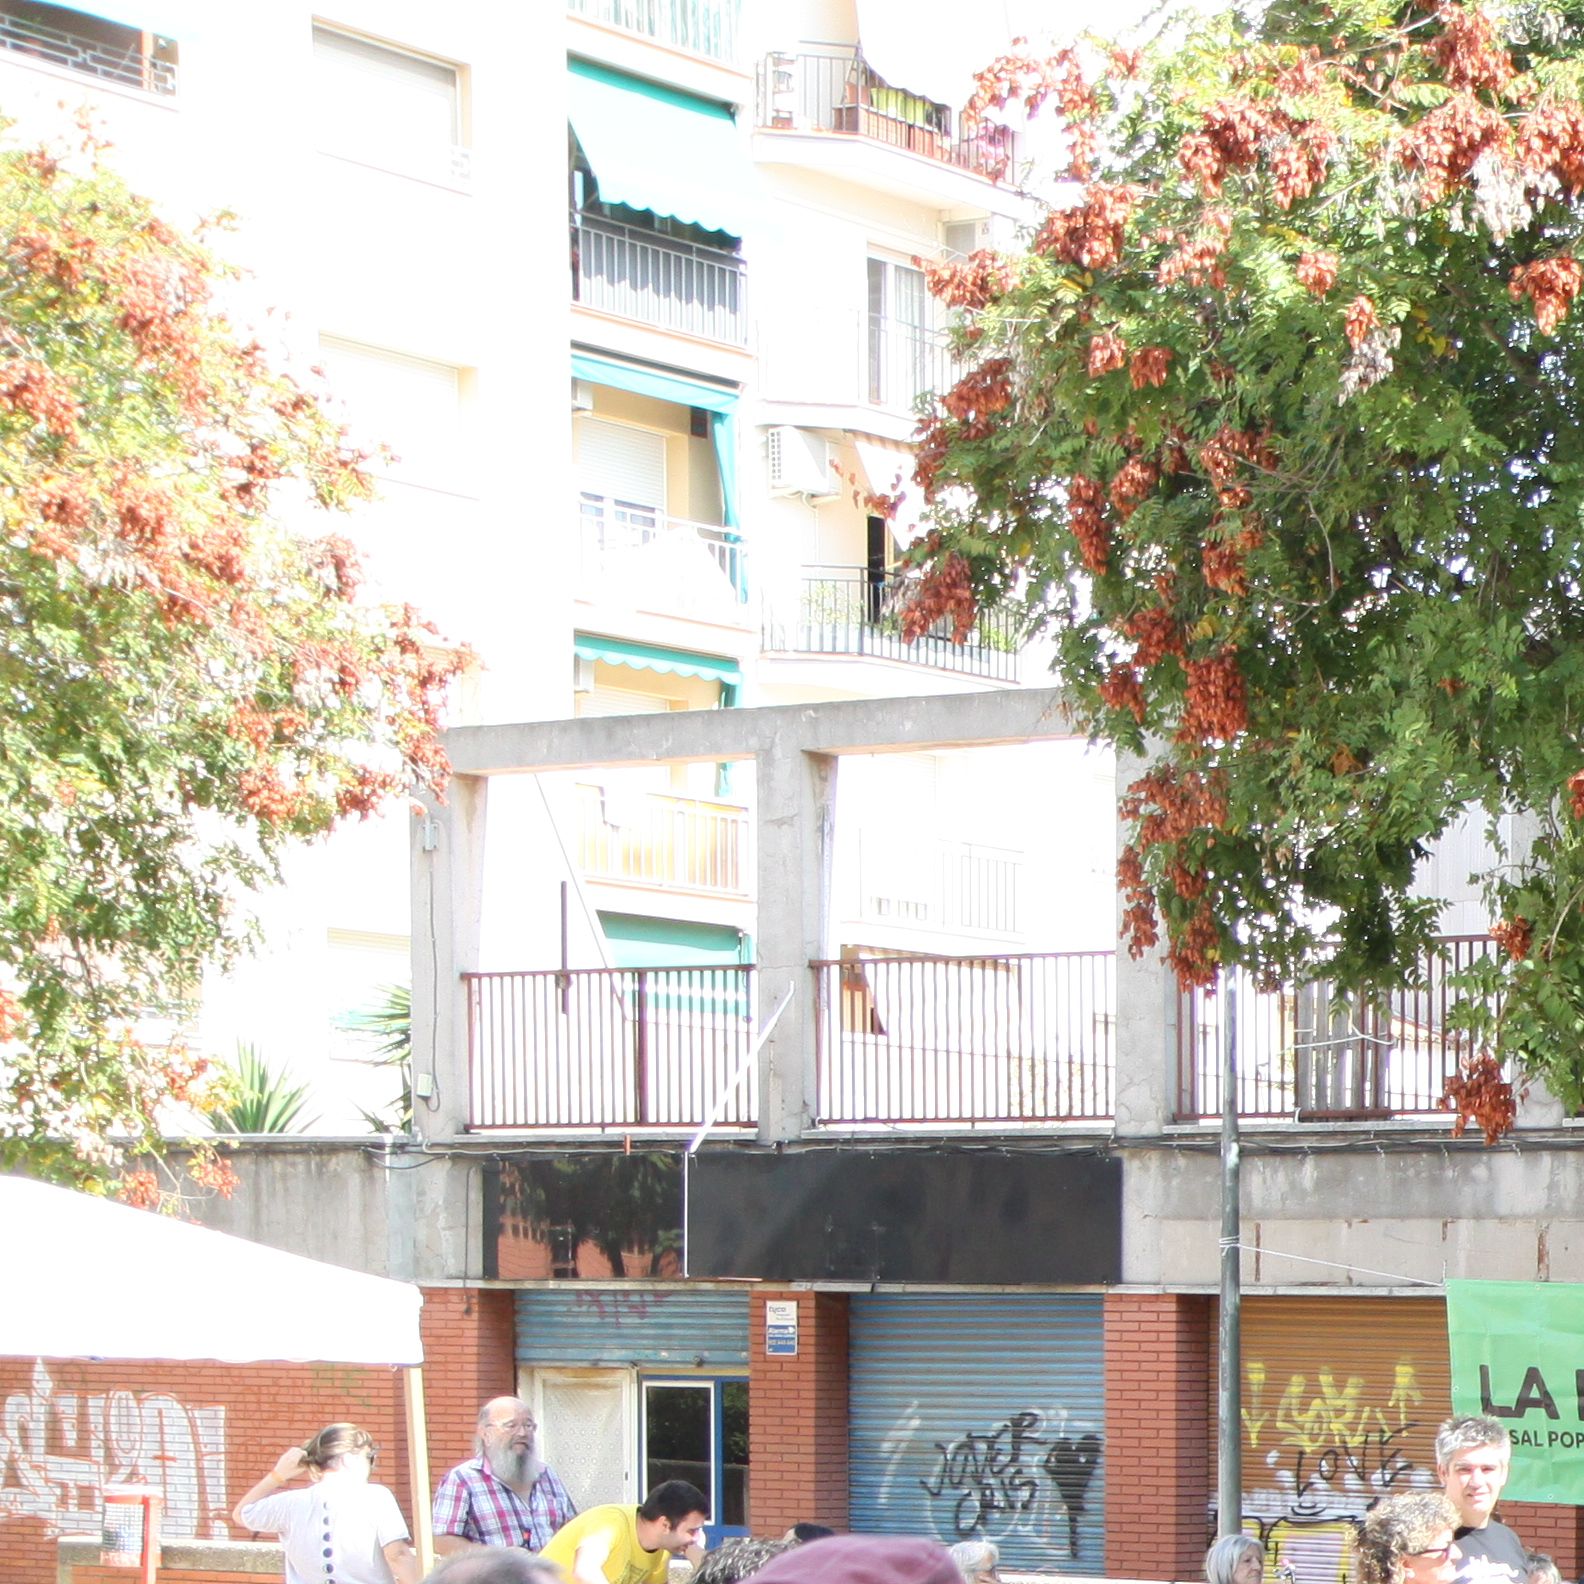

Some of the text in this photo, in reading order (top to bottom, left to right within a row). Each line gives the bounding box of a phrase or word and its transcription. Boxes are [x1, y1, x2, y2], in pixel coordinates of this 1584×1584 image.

[1479, 1364, 1560, 1421] LA
[1296, 1420, 1420, 1499] LOVE
[1509, 1429, 1544, 1448] SAL
